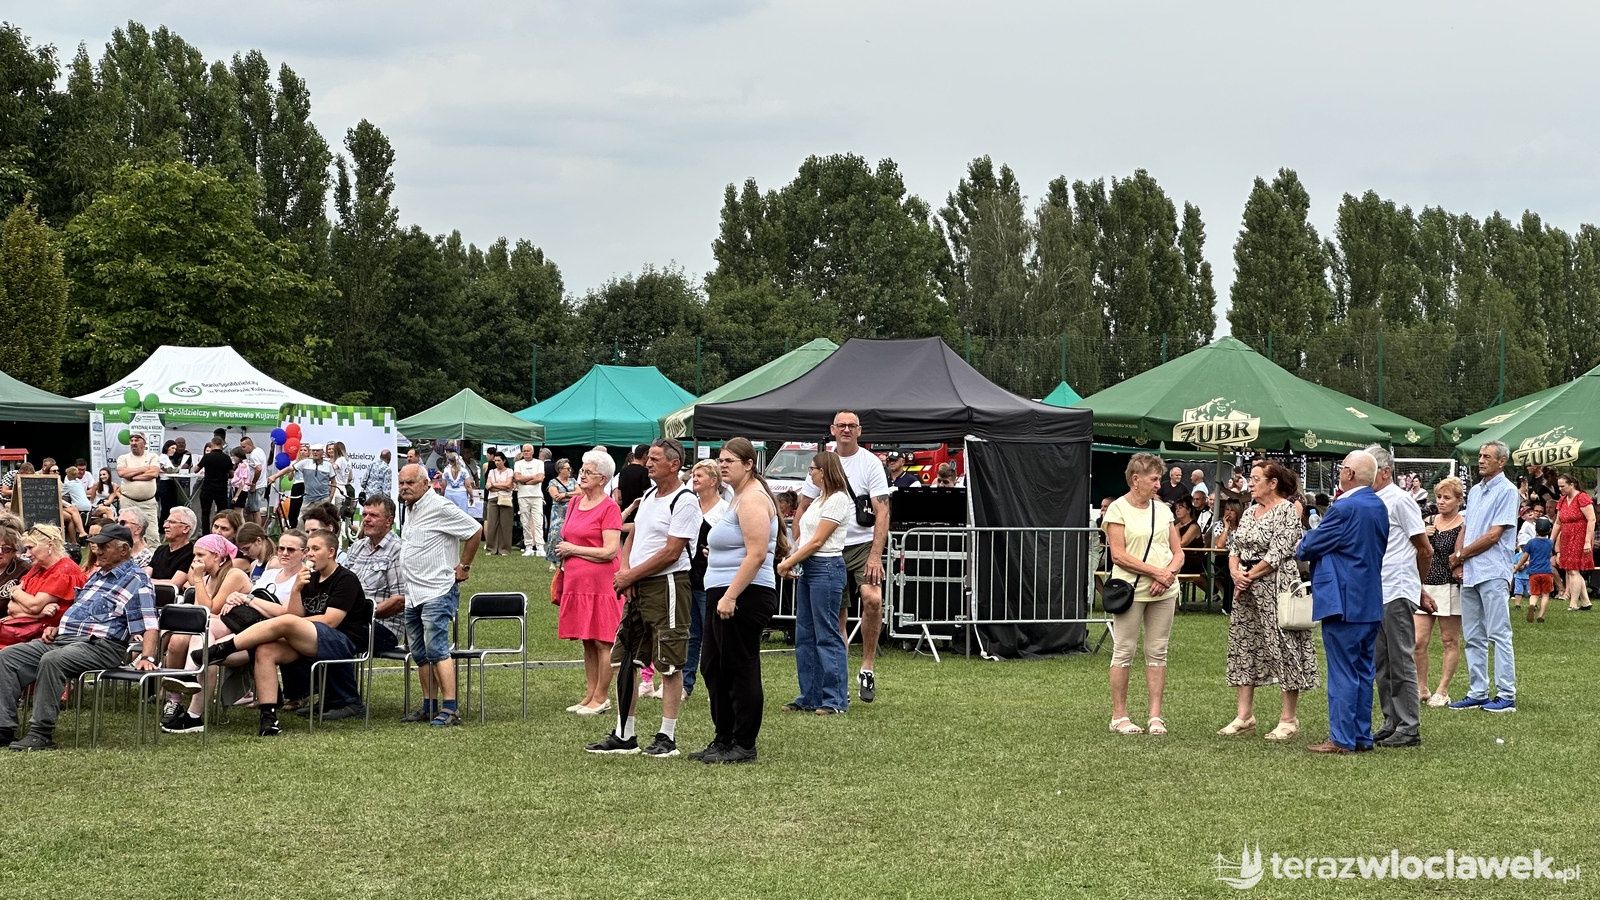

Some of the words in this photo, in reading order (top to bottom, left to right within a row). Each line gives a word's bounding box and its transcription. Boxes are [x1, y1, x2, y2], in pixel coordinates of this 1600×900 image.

[168, 408, 210, 419] Spółdzielczy
[219, 410, 254, 420] Piotrkowie
[255, 412, 279, 421] Kujaws
